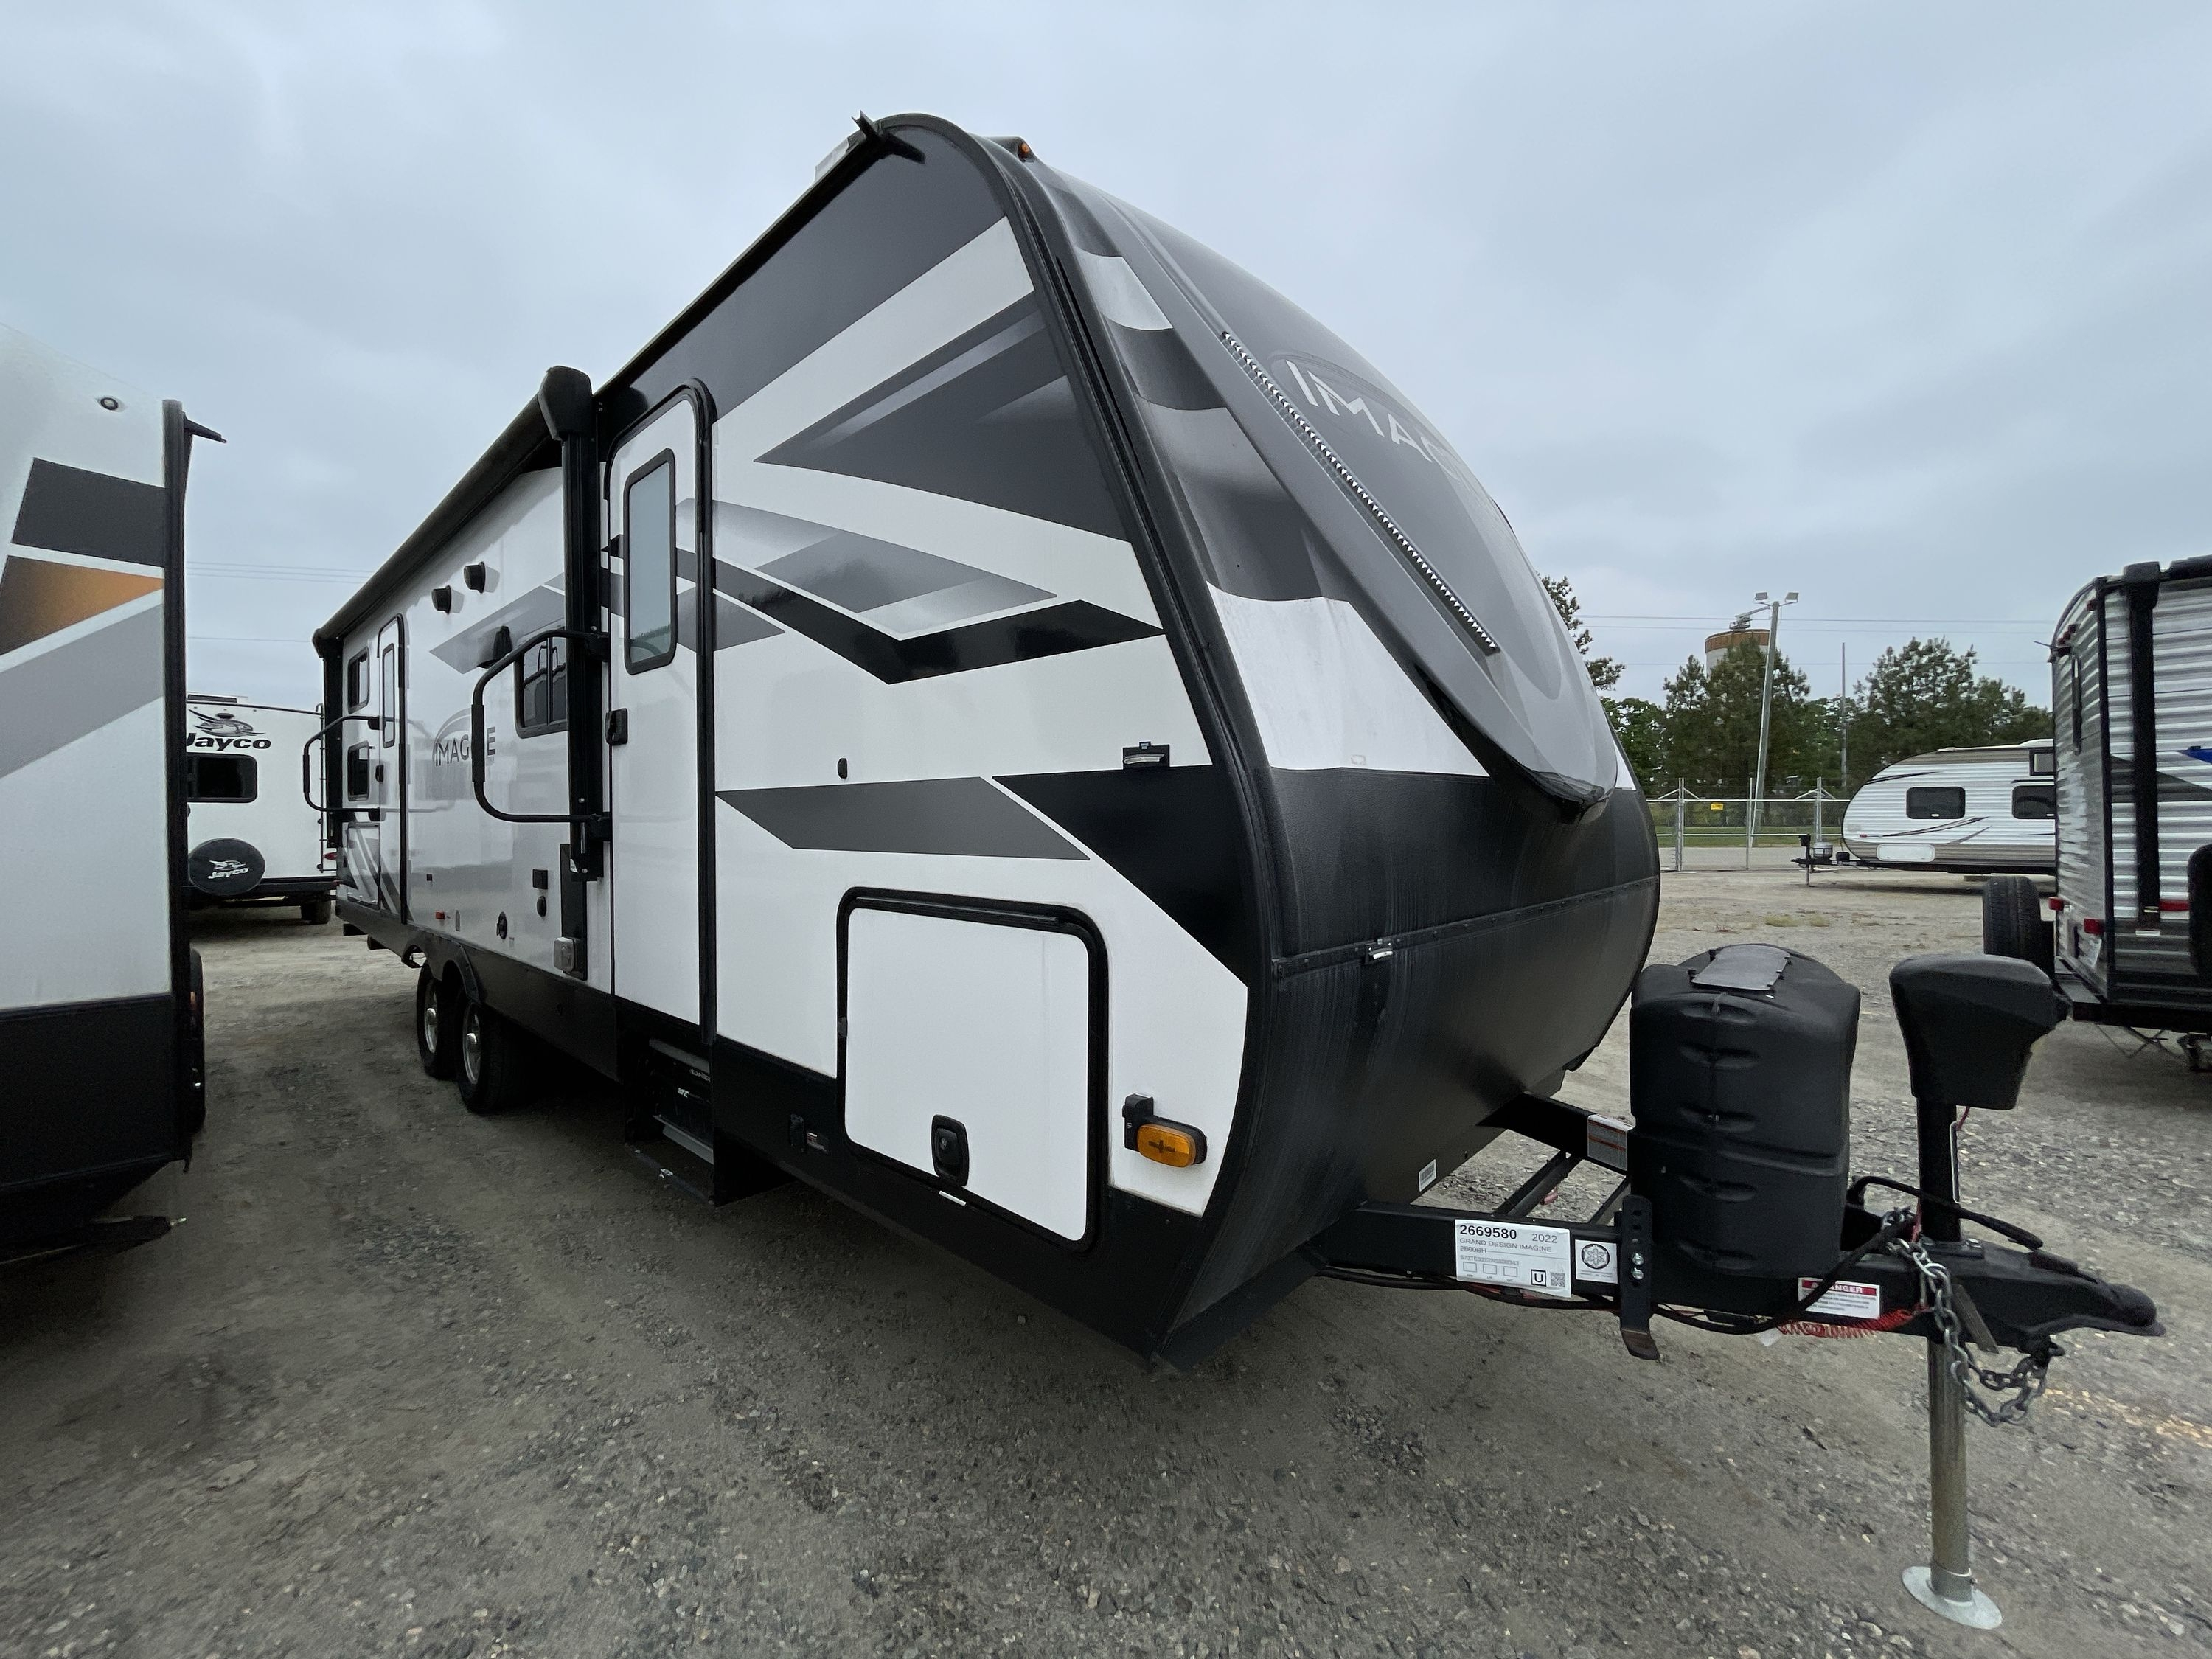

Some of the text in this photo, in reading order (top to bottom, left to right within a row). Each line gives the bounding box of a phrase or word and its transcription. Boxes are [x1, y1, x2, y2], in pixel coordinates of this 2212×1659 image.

[186, 732, 271, 751] Jayco
[435, 726, 495, 766] IMAGE
[207, 867, 249, 880] Jayco
[1460, 1225, 1557, 1243] 2669580 2022
[1460, 1238, 1552, 1253] GRAND DESIGN IMAGINE
[1534, 1273, 1543, 1283] U
[1830, 1284, 1863, 1293] ANGER
